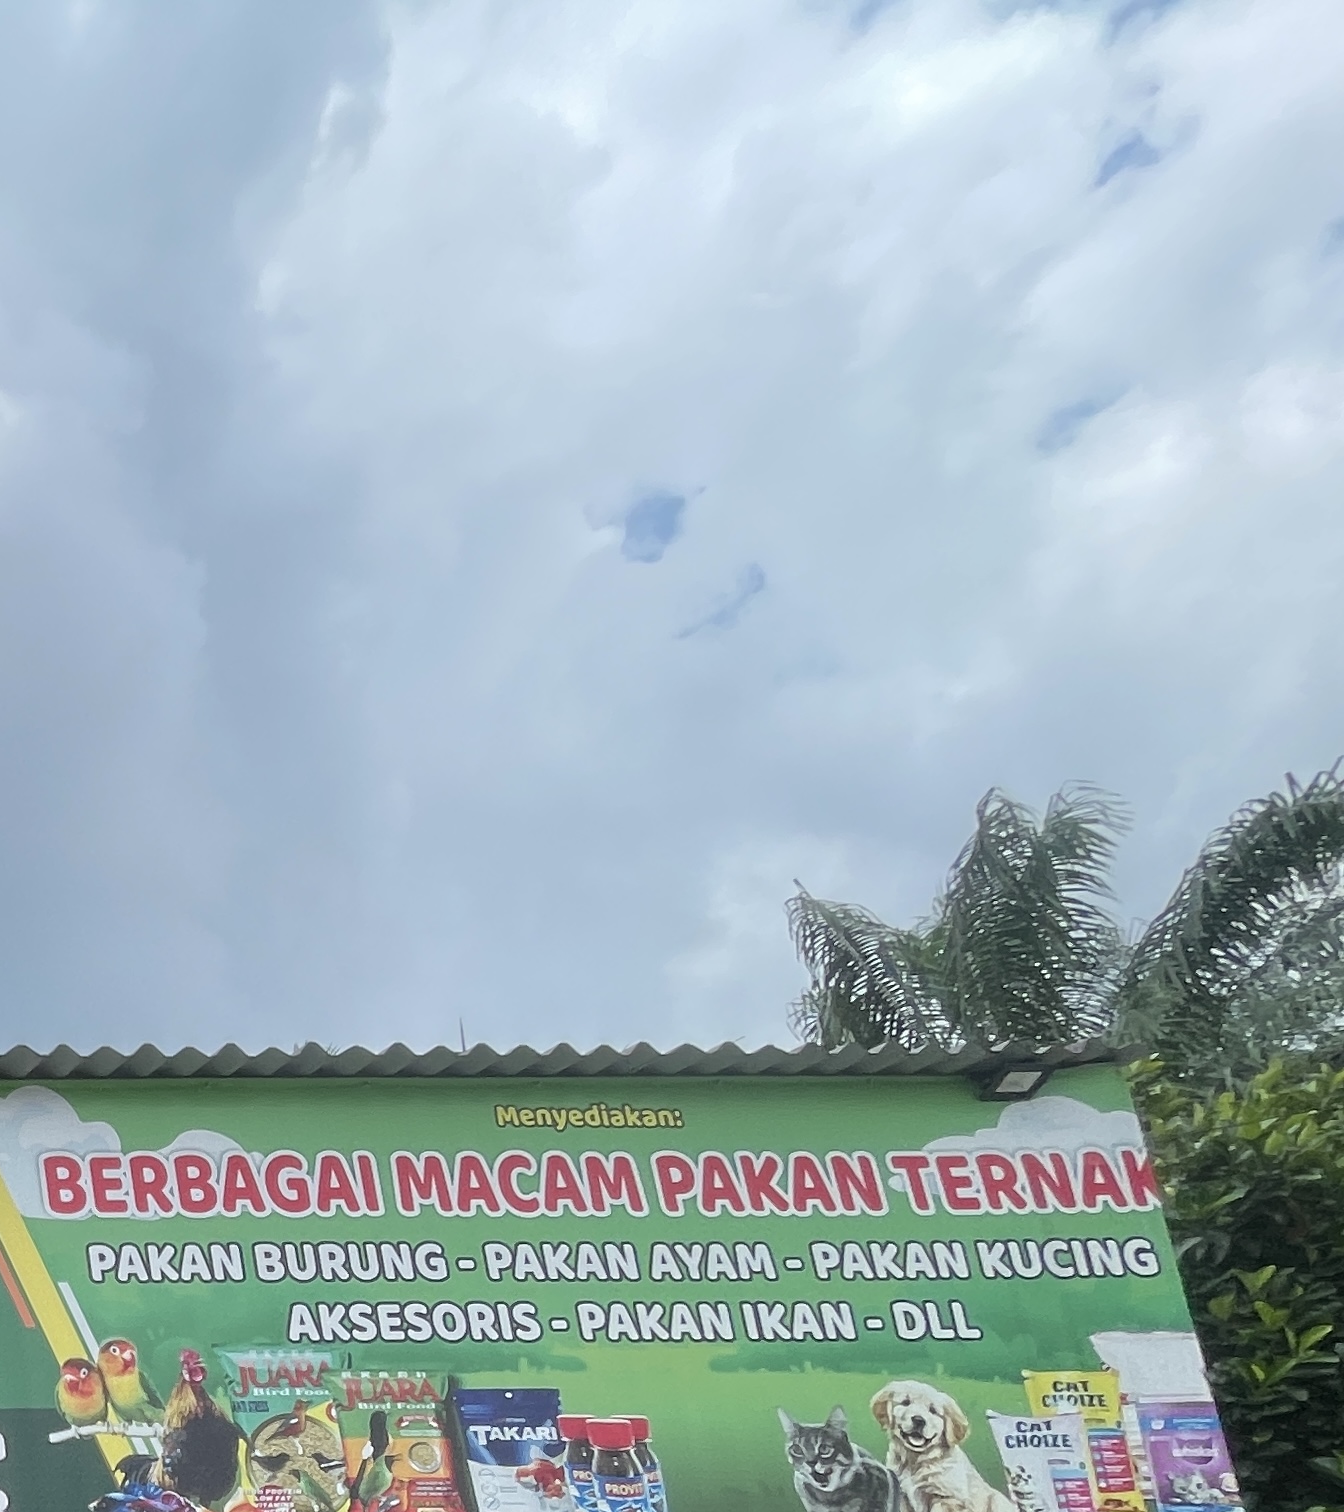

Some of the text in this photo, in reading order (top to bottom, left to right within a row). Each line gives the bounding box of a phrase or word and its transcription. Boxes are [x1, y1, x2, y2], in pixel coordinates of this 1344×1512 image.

[495, 1103, 683, 1131] Menyediakan:
[40, 1146, 1161, 1221] BERBAGAI MACAM PAKAN TERNAK
[87, 1243, 243, 1284] PAKAN
[256, 1241, 448, 1284] BURUNG
[484, 1241, 640, 1282] PAKAN
[652, 1241, 776, 1282] AYAM
[813, 1239, 969, 1280] PAKAN
[980, 1237, 1160, 1278] KUCING
[288, 1301, 539, 1345] AKSESORIS
[579, 1301, 733, 1343] PAKAN
[743, 1301, 857, 1343] IKAN
[893, 1301, 982, 1342] DLL
[1052, 1380, 1089, 1393] CAT
[1042, 1394, 1108, 1408] COIZE
[469, 1425, 558, 1446] TAKARI
[1015, 1420, 1053, 1433] CAT
[1004, 1434, 1073, 1449] CHOIZE
